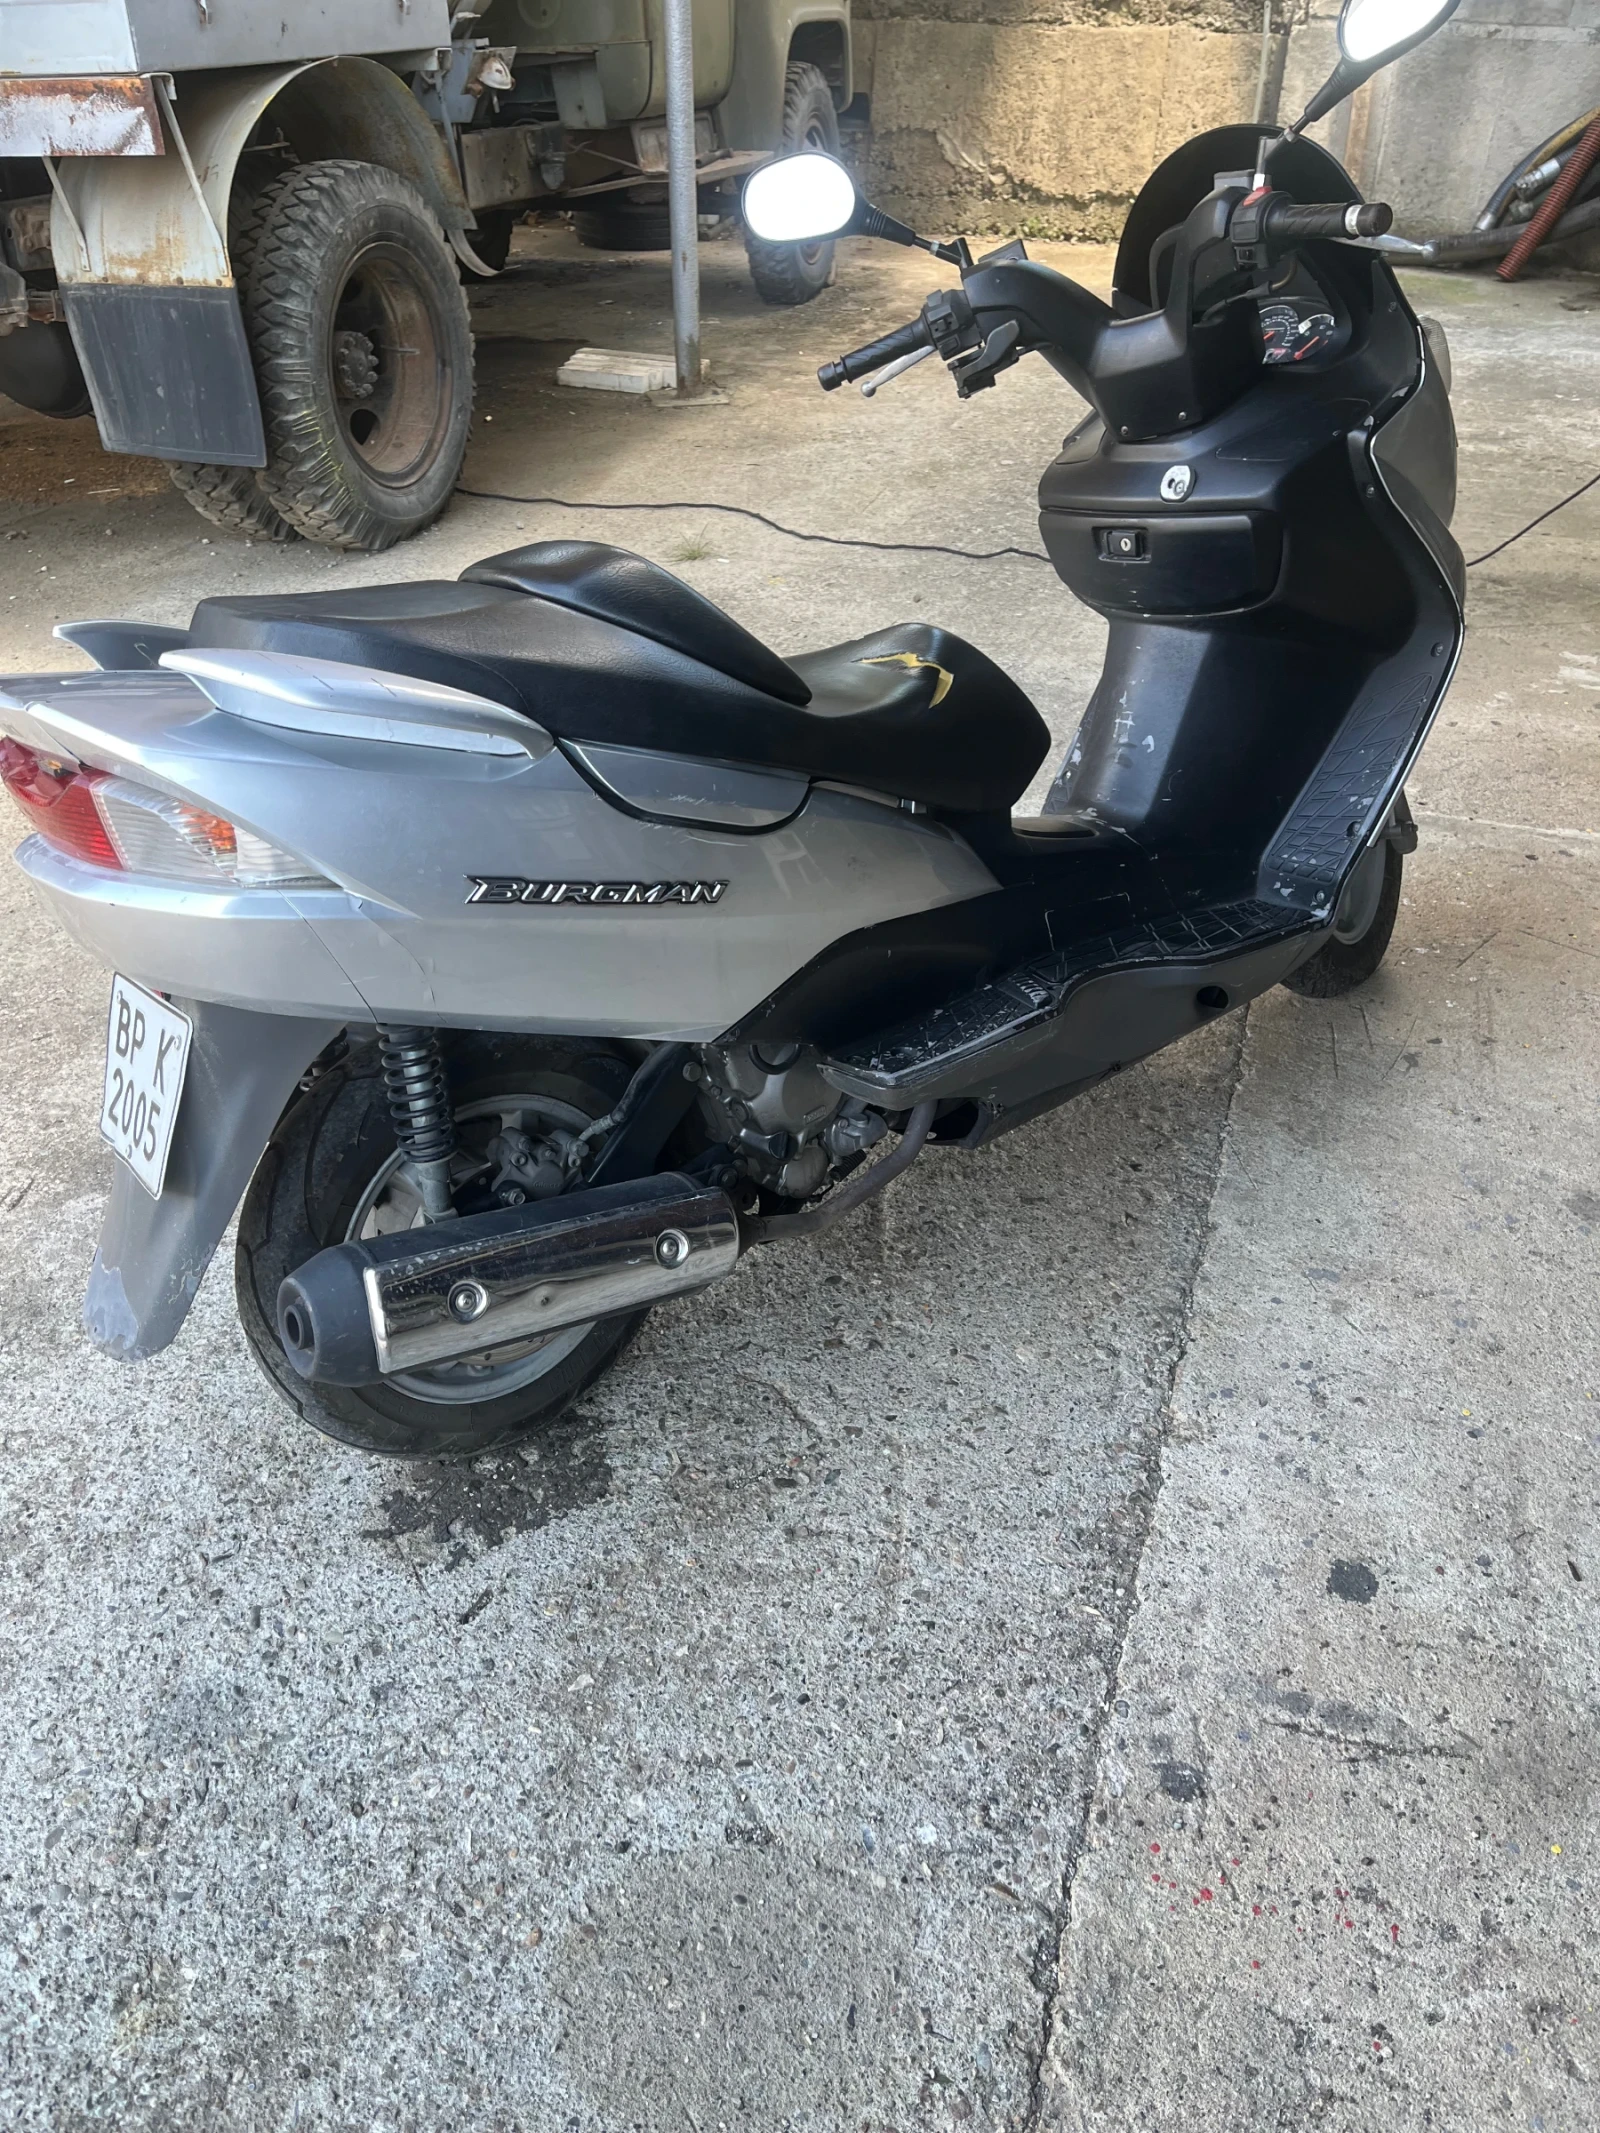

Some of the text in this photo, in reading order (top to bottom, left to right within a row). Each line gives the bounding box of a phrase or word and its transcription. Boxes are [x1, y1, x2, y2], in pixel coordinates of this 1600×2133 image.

[463, 874, 729, 904] BURGMAN
[115, 997, 175, 1097] BP K
[107, 1067, 161, 1162] 2005
